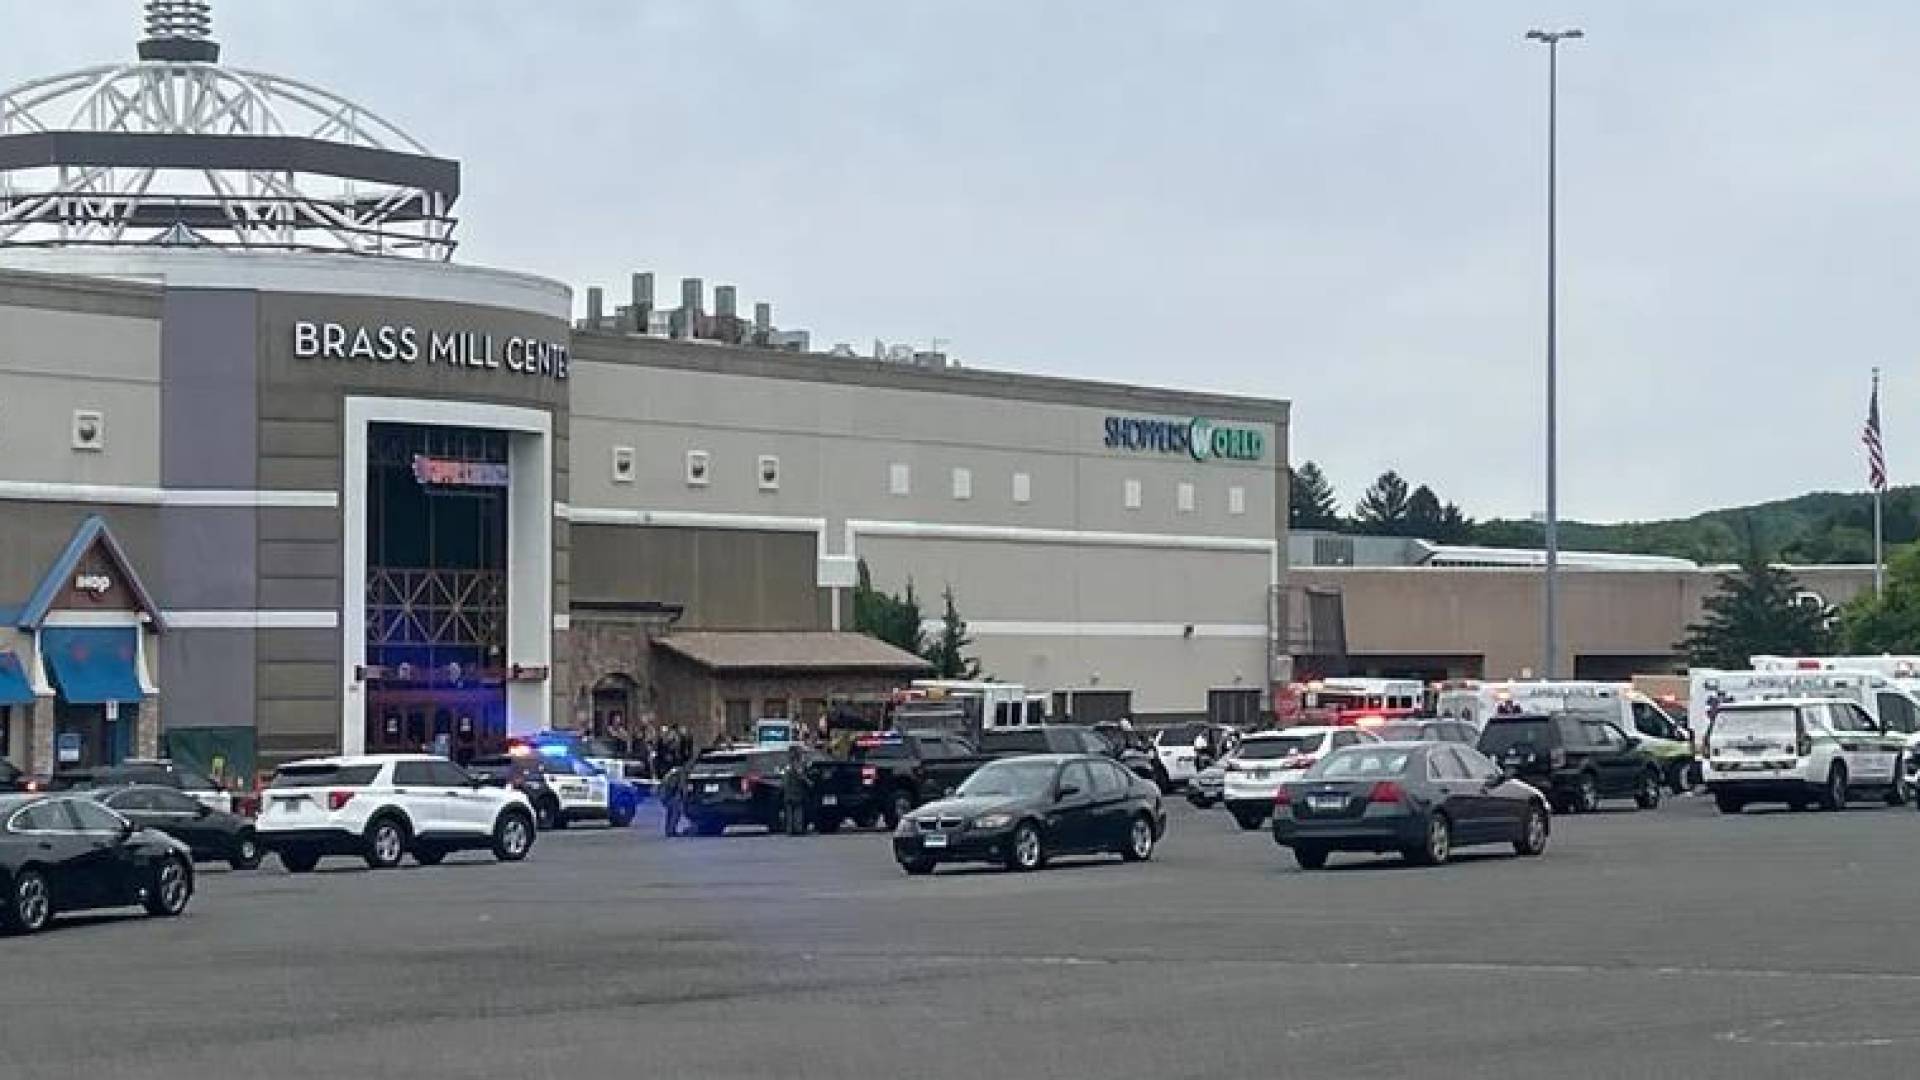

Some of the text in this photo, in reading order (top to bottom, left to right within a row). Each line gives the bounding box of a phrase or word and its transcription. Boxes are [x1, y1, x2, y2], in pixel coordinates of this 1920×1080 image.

[294, 320, 418, 361] BRASS
[430, 330, 499, 368] MILL
[1189, 416, 1265, 462] WORLD
